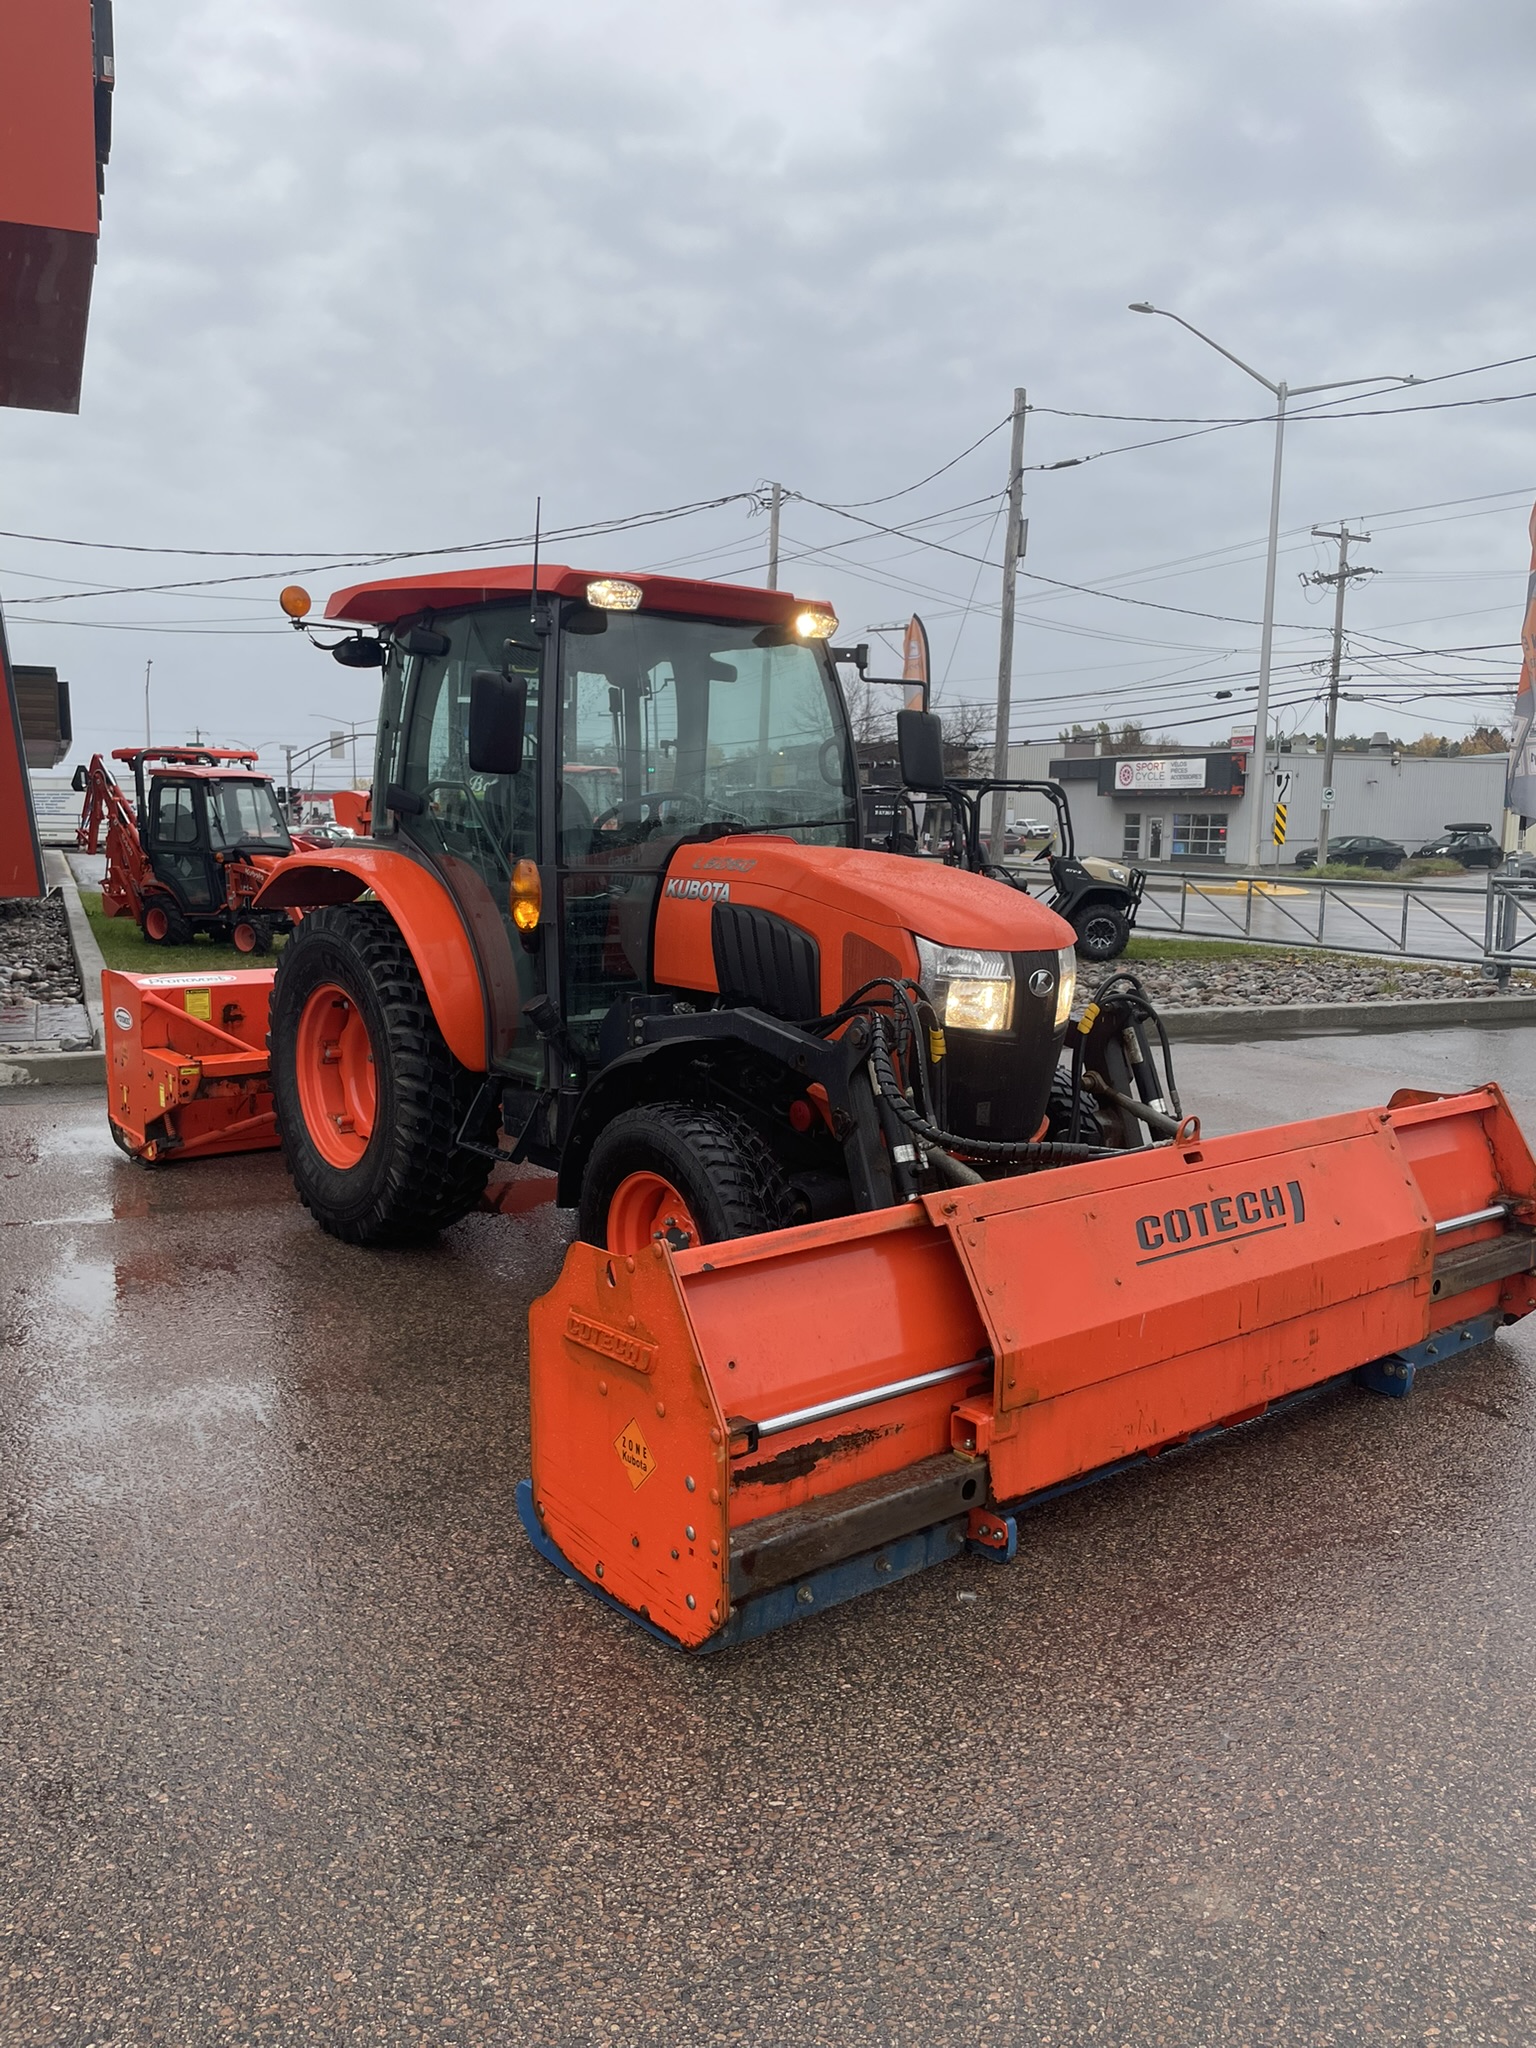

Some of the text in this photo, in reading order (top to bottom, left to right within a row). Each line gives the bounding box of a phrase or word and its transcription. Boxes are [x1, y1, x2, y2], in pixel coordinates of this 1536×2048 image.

[1135, 772, 1165, 781] CYCLE
[1136, 762, 1165, 771] SPORT
[665, 879, 730, 903] KUBOTA
[148, 976, 226, 985] Pronovost
[1135, 1185, 1285, 1250] COTECH
[567, 1316, 640, 1363] COTECH
[622, 1436, 647, 1459] ZONE
[622, 1450, 647, 1472] Kubota
